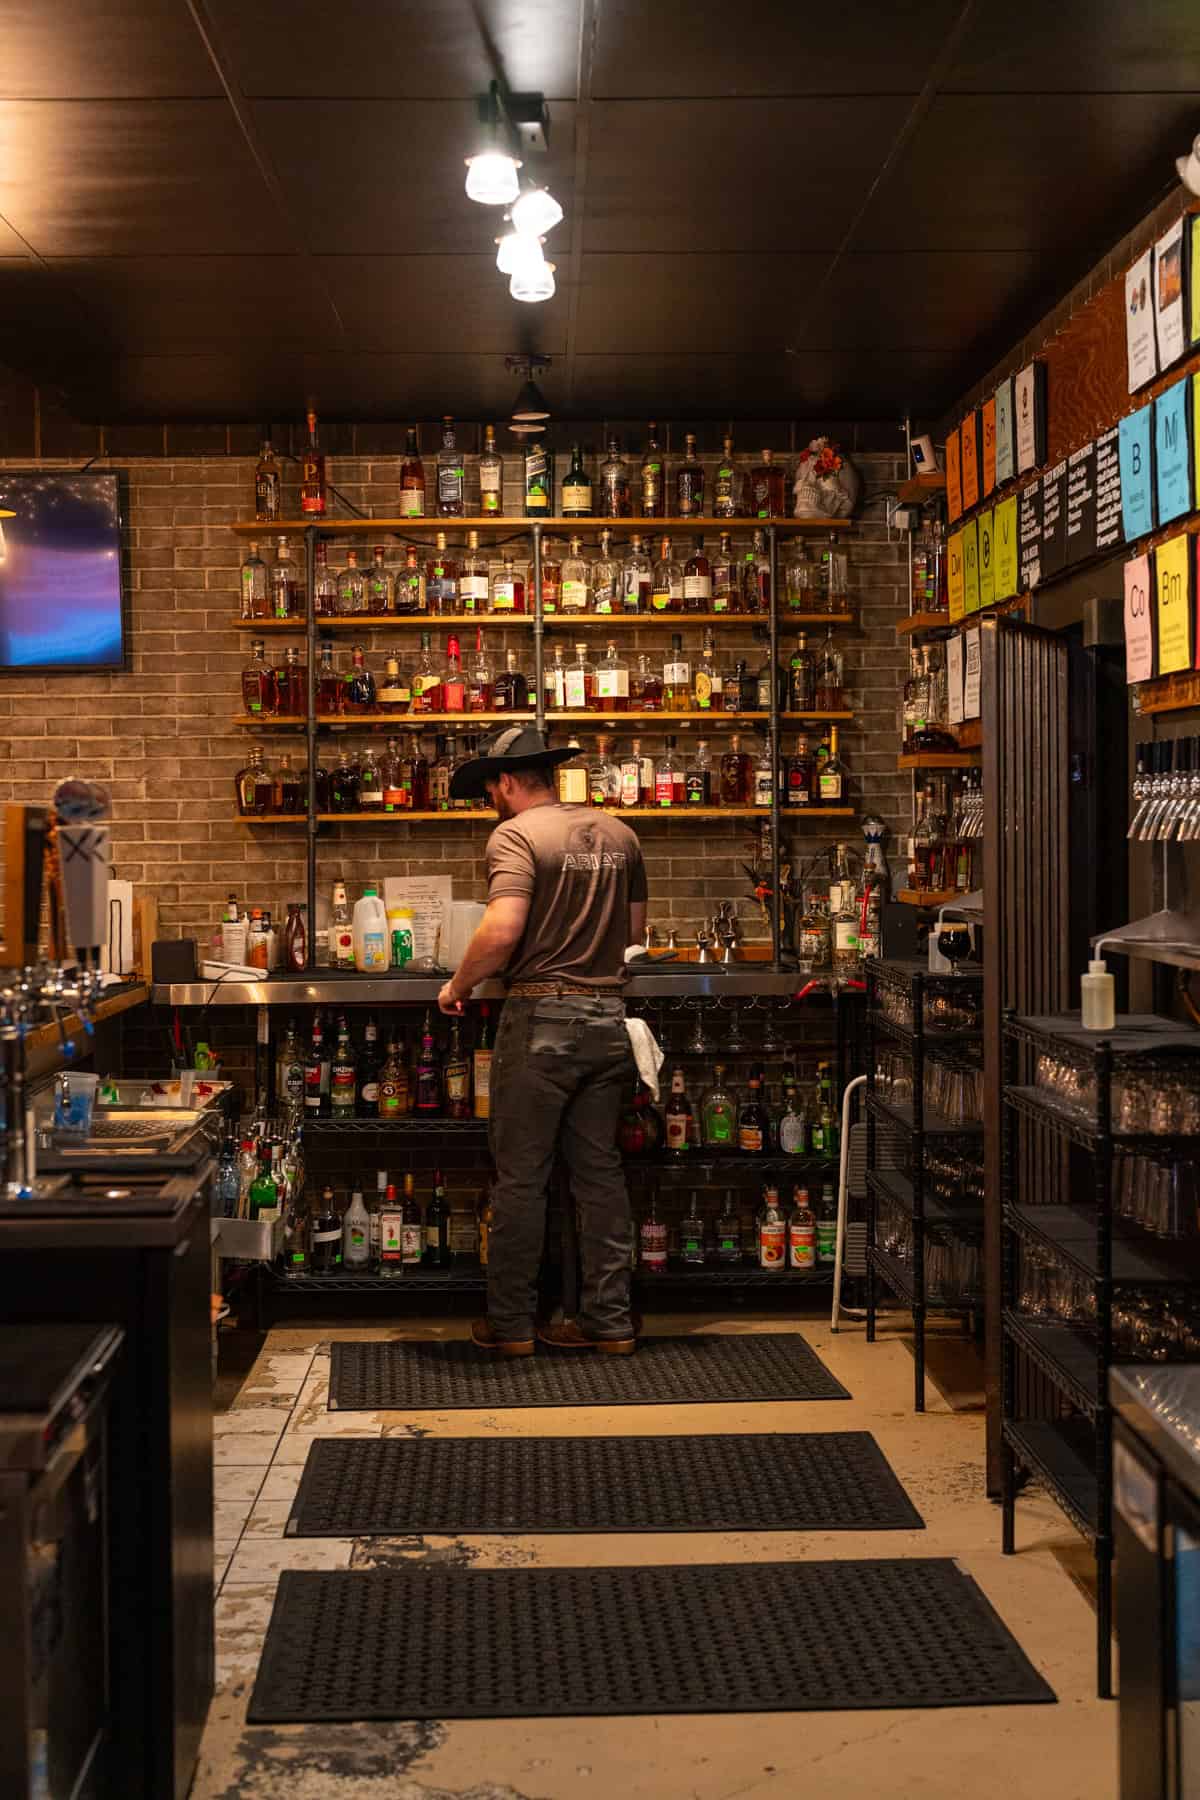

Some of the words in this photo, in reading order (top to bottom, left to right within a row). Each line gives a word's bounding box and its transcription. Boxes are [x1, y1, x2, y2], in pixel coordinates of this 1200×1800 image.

[1132, 443, 1142, 476] B
[1130, 585, 1145, 619] Co
[1162, 571, 1181, 607] Bm
[562, 853, 625, 871] ARIAT
